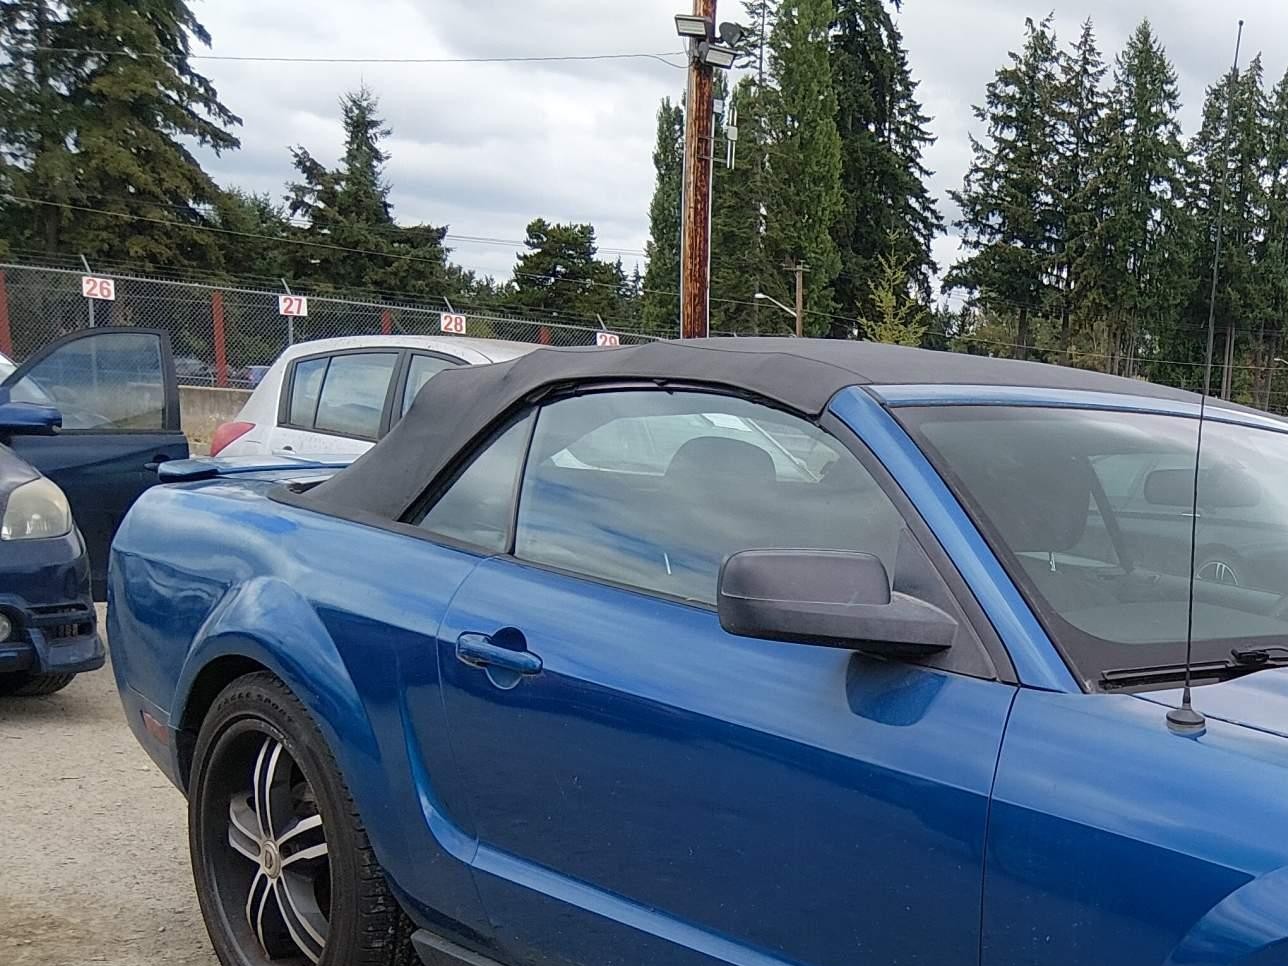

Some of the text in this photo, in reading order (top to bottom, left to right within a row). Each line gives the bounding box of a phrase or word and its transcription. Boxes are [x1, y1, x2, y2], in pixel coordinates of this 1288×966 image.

[85, 278, 112, 298] 26
[283, 297, 303, 315] 27
[443, 315, 463, 332] 28
